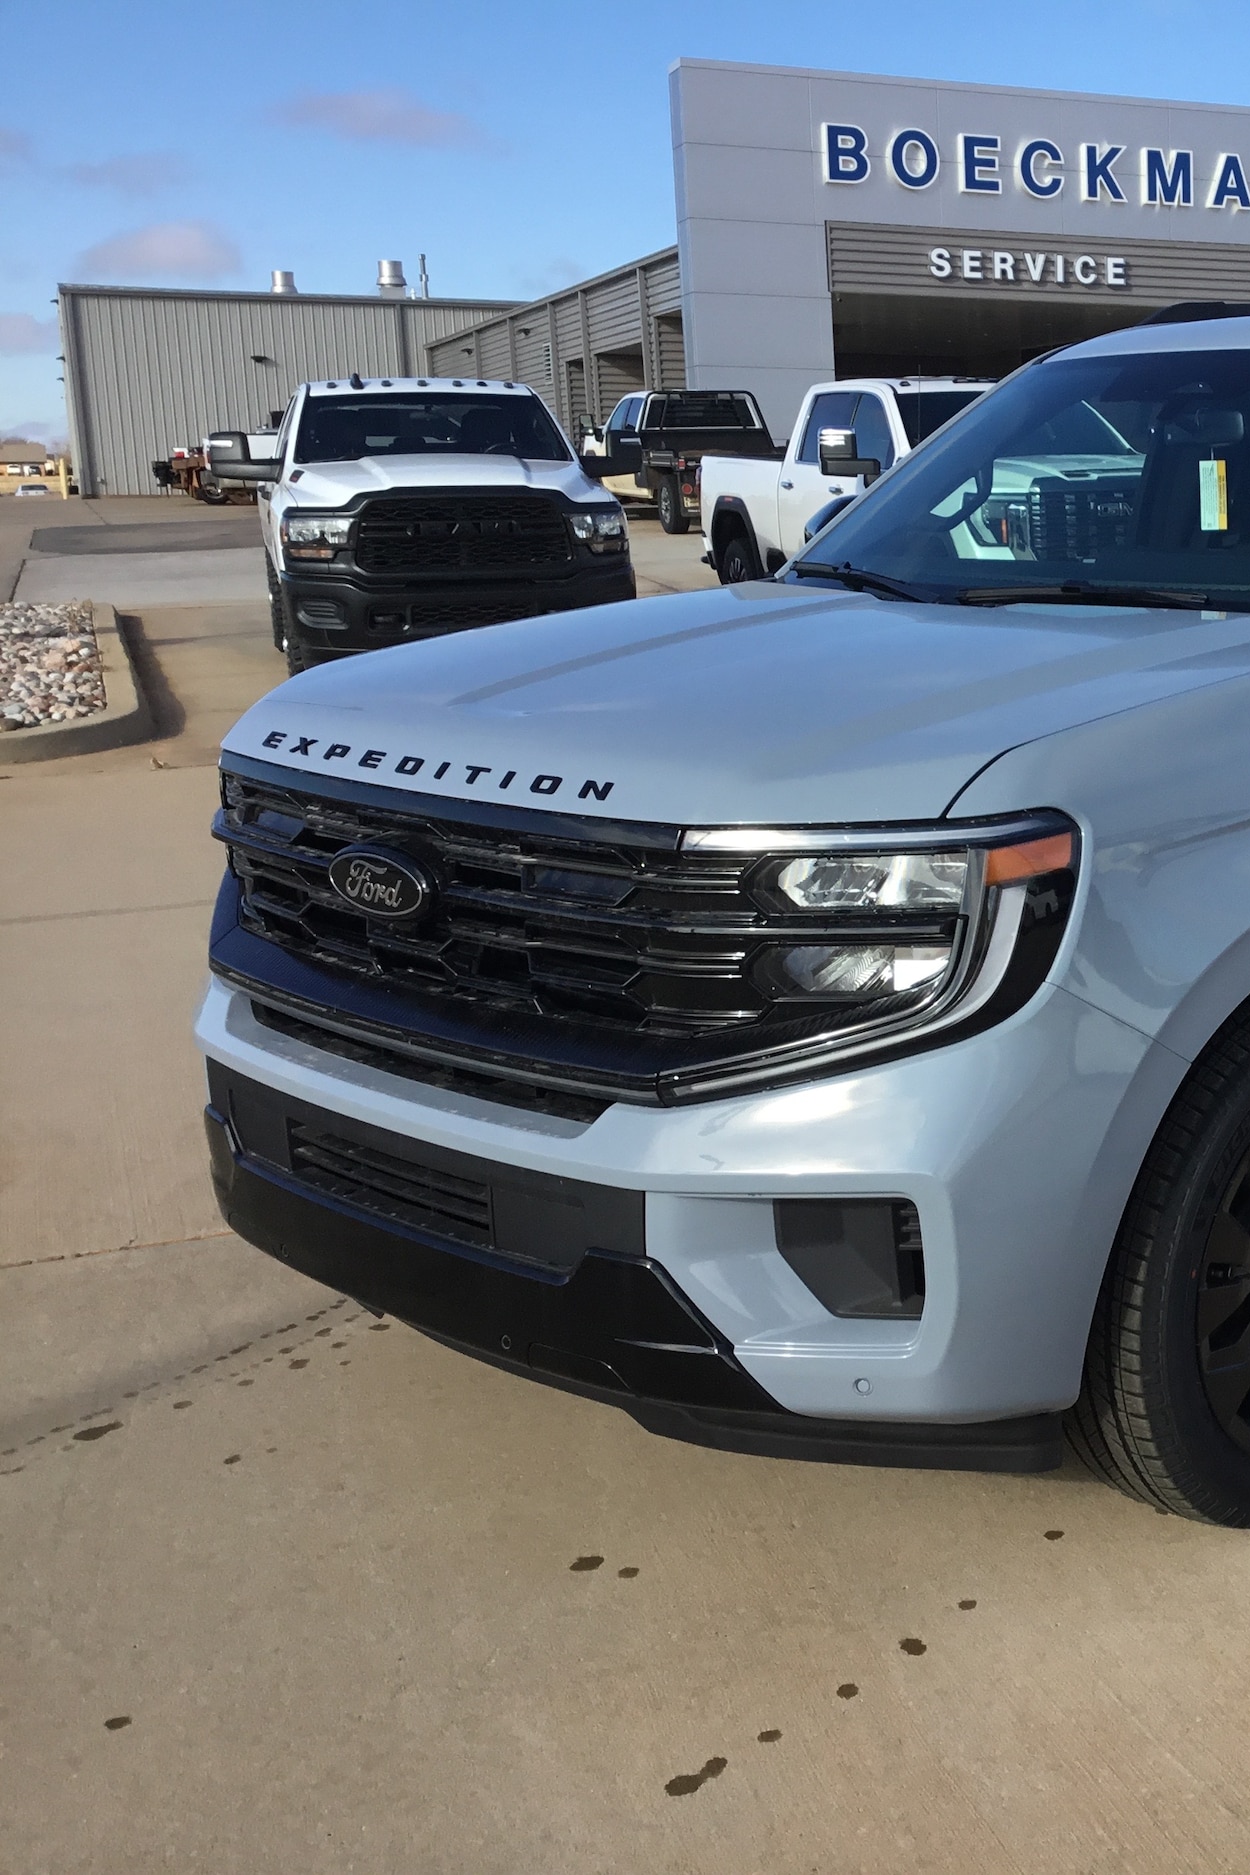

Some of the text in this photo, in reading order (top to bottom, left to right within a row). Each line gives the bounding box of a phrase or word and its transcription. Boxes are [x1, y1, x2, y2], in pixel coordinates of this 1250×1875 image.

[930, 247, 1127, 286] SERVICE
[262, 731, 614, 801] EXPEDITION
[346, 858, 403, 908] Ford
